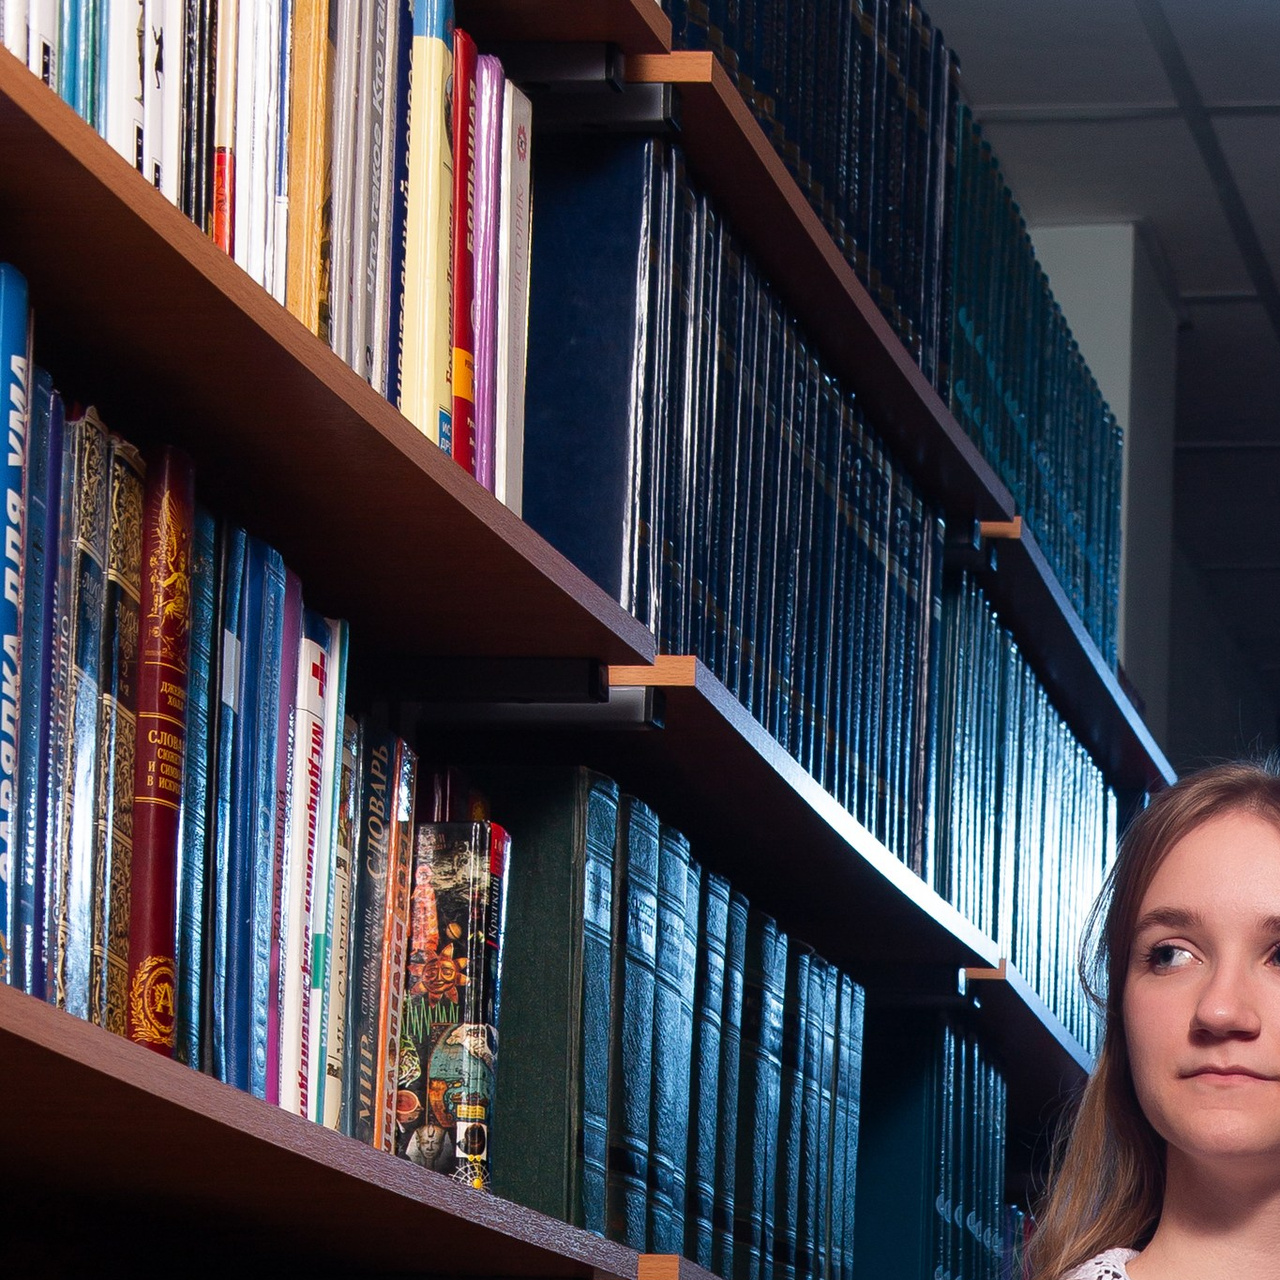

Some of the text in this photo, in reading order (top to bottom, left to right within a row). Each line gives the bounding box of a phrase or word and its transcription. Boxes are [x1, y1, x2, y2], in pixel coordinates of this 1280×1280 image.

[8, 352, 27, 466] УМА
[4, 488, 22, 604] ДЛЯ
[366, 744, 389, 880] СЛОВАРЬ
[488, 876, 500, 939] Краткий
[359, 1034, 373, 1127] МИР
